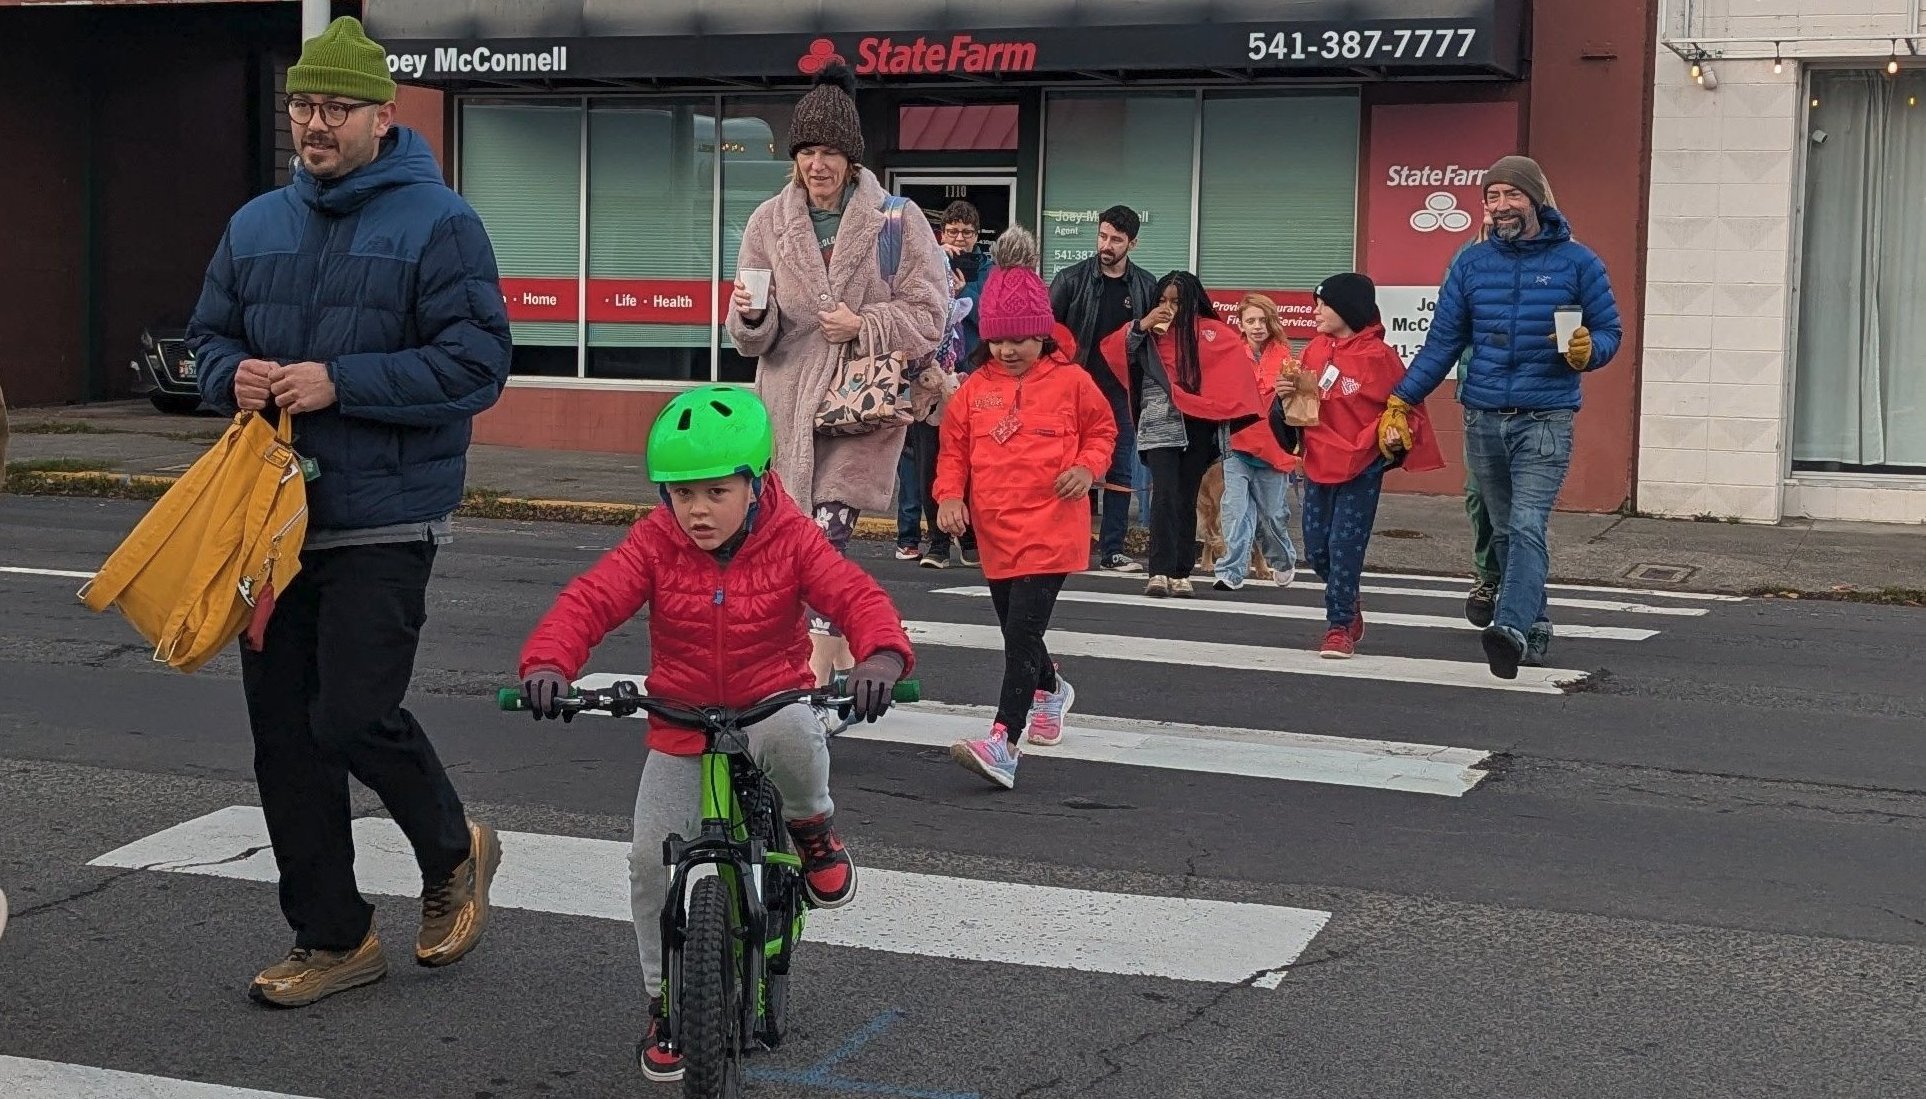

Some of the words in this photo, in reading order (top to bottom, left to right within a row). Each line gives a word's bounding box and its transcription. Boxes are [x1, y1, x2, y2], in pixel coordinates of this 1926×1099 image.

[1248, 28, 1477, 60] 541-387-7777
[386, 53, 427, 78] oey
[434, 46, 567, 72] McConnell
[945, 185, 967, 198] 1110
[1054, 226, 1079, 236] Agent
[1054, 249, 1097, 260] 541-387
[523, 292, 557, 305] Home
[615, 293, 637, 307] Life
[653, 294, 693, 308] Health
[1416, 297, 1436, 312] Jo
[1212, 301, 1239, 312] Provi
[1276, 305, 1312, 314] urance
